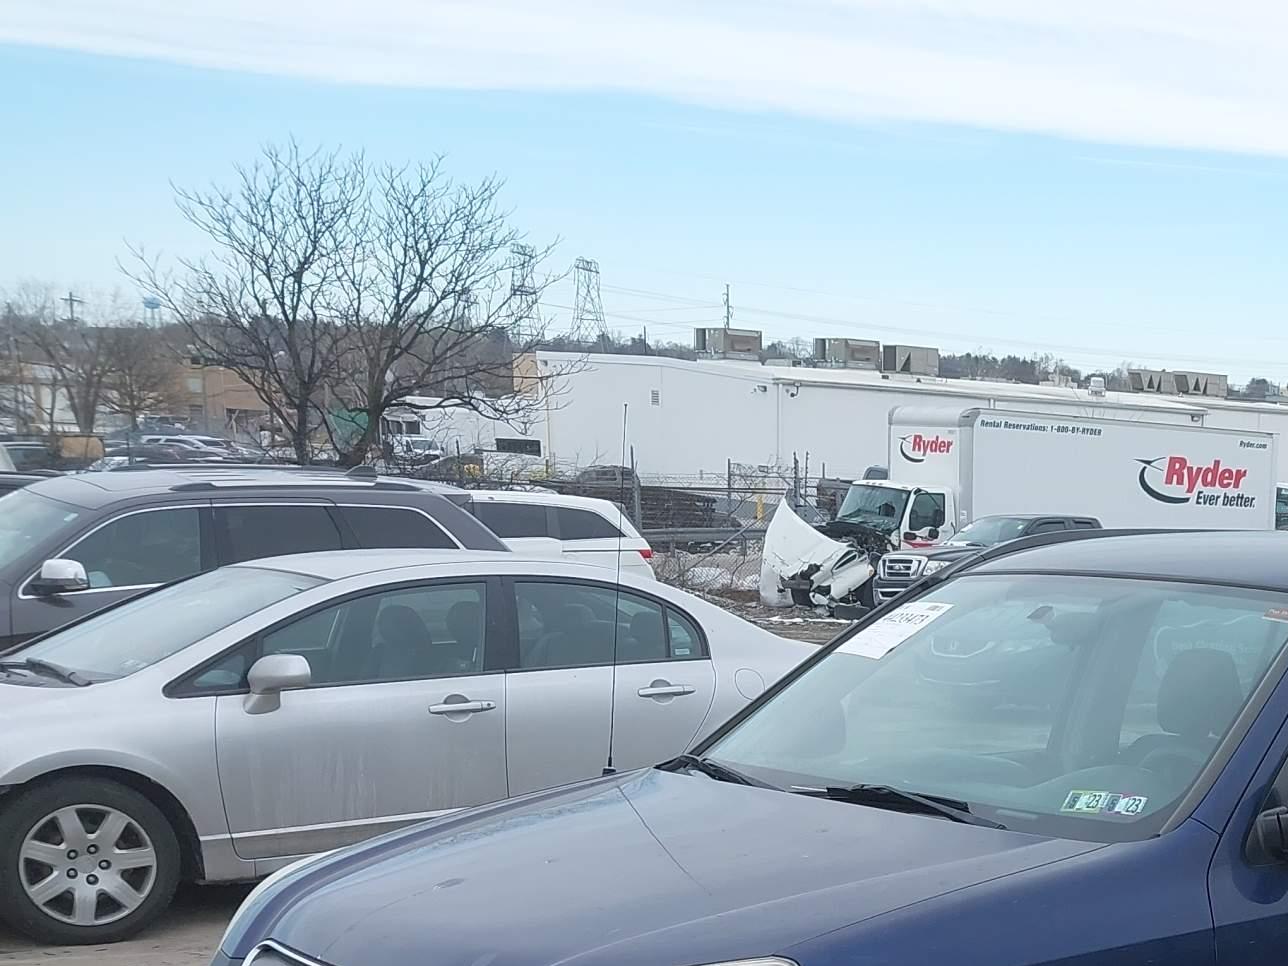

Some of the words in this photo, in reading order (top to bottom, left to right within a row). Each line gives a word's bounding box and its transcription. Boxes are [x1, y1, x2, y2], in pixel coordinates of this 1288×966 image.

[980, 418, 1002, 429] Rental
[1004, 421, 1048, 433] Reservations:
[911, 434, 954, 457] Ryder
[1239, 440, 1268, 449] Ryder.com
[1164, 456, 1248, 494] Ryder
[1195, 490, 1220, 507] Ever
[1222, 492, 1256, 508] better.
[1086, 794, 1102, 808] 23
[1126, 798, 1142, 813] 23
